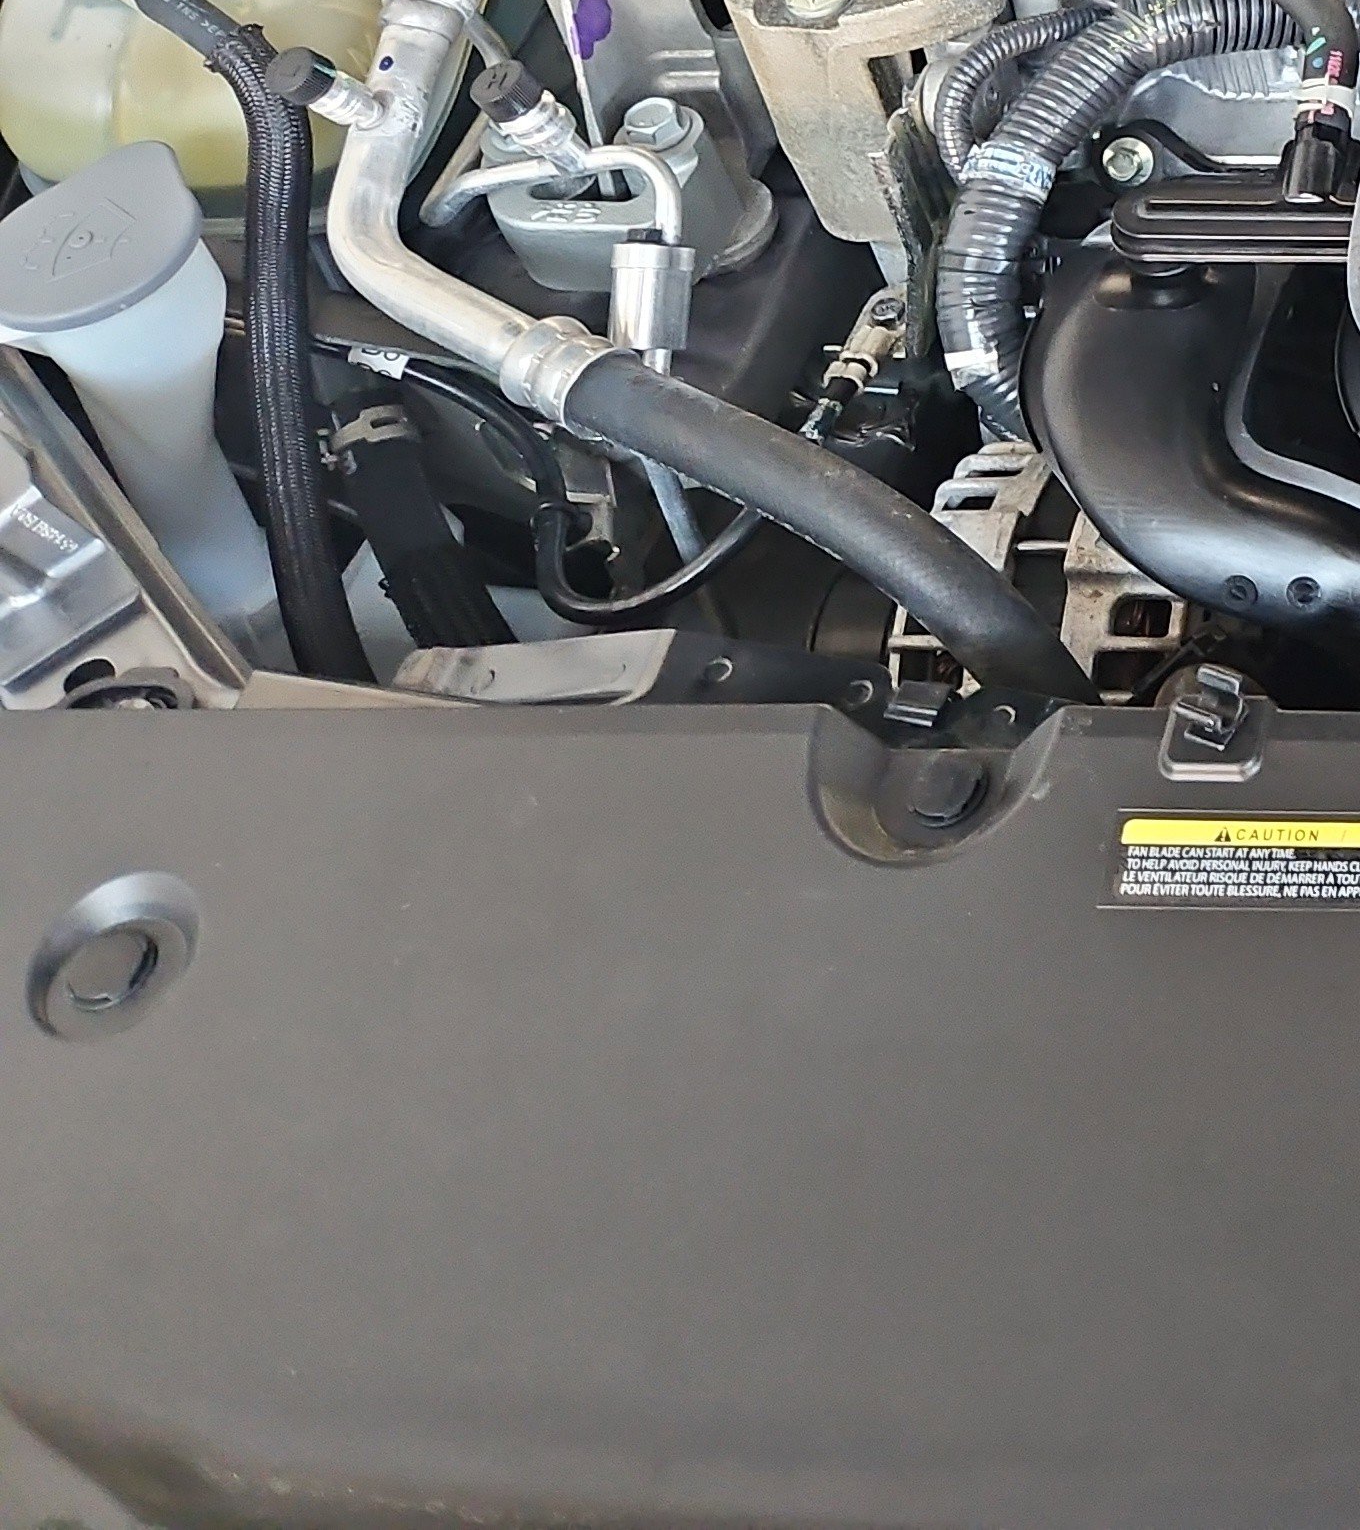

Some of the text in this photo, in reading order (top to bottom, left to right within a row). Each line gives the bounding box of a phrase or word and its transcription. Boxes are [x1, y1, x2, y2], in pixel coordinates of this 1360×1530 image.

[1236, 828, 1320, 842] CAUTION
[1128, 847, 1148, 857] FAN
[1149, 847, 1180, 857] BLADE
[1182, 847, 1205, 858] CAN
[1206, 848, 1235, 858] START
[1236, 848, 1249, 858] AT
[1249, 848, 1271, 859] ANY
[1127, 859, 1140, 869] TO
[1142, 859, 1167, 870] HELP
[1168, 859, 1199, 870] AVOID
[1200, 860, 1249, 871] PERSONAL
[1288, 861, 1312, 871] KEEP
[1313, 861, 1348, 872] HANDS
[1123, 871, 1136, 881] LE
[1138, 871, 1207, 883] VENTILATEUR
[1209, 872, 1248, 883] RISQUE
[1249, 872, 1264, 883] DE
[1266, 871, 1325, 884] DÉMARRER
[1121, 883, 1151, 895] POUR
[1191, 884, 1225, 896] TOUTE
[1283, 886, 1299, 897] NE
[1300, 886, 1320, 897] PAS
[1322, 886, 1338, 897] EN
